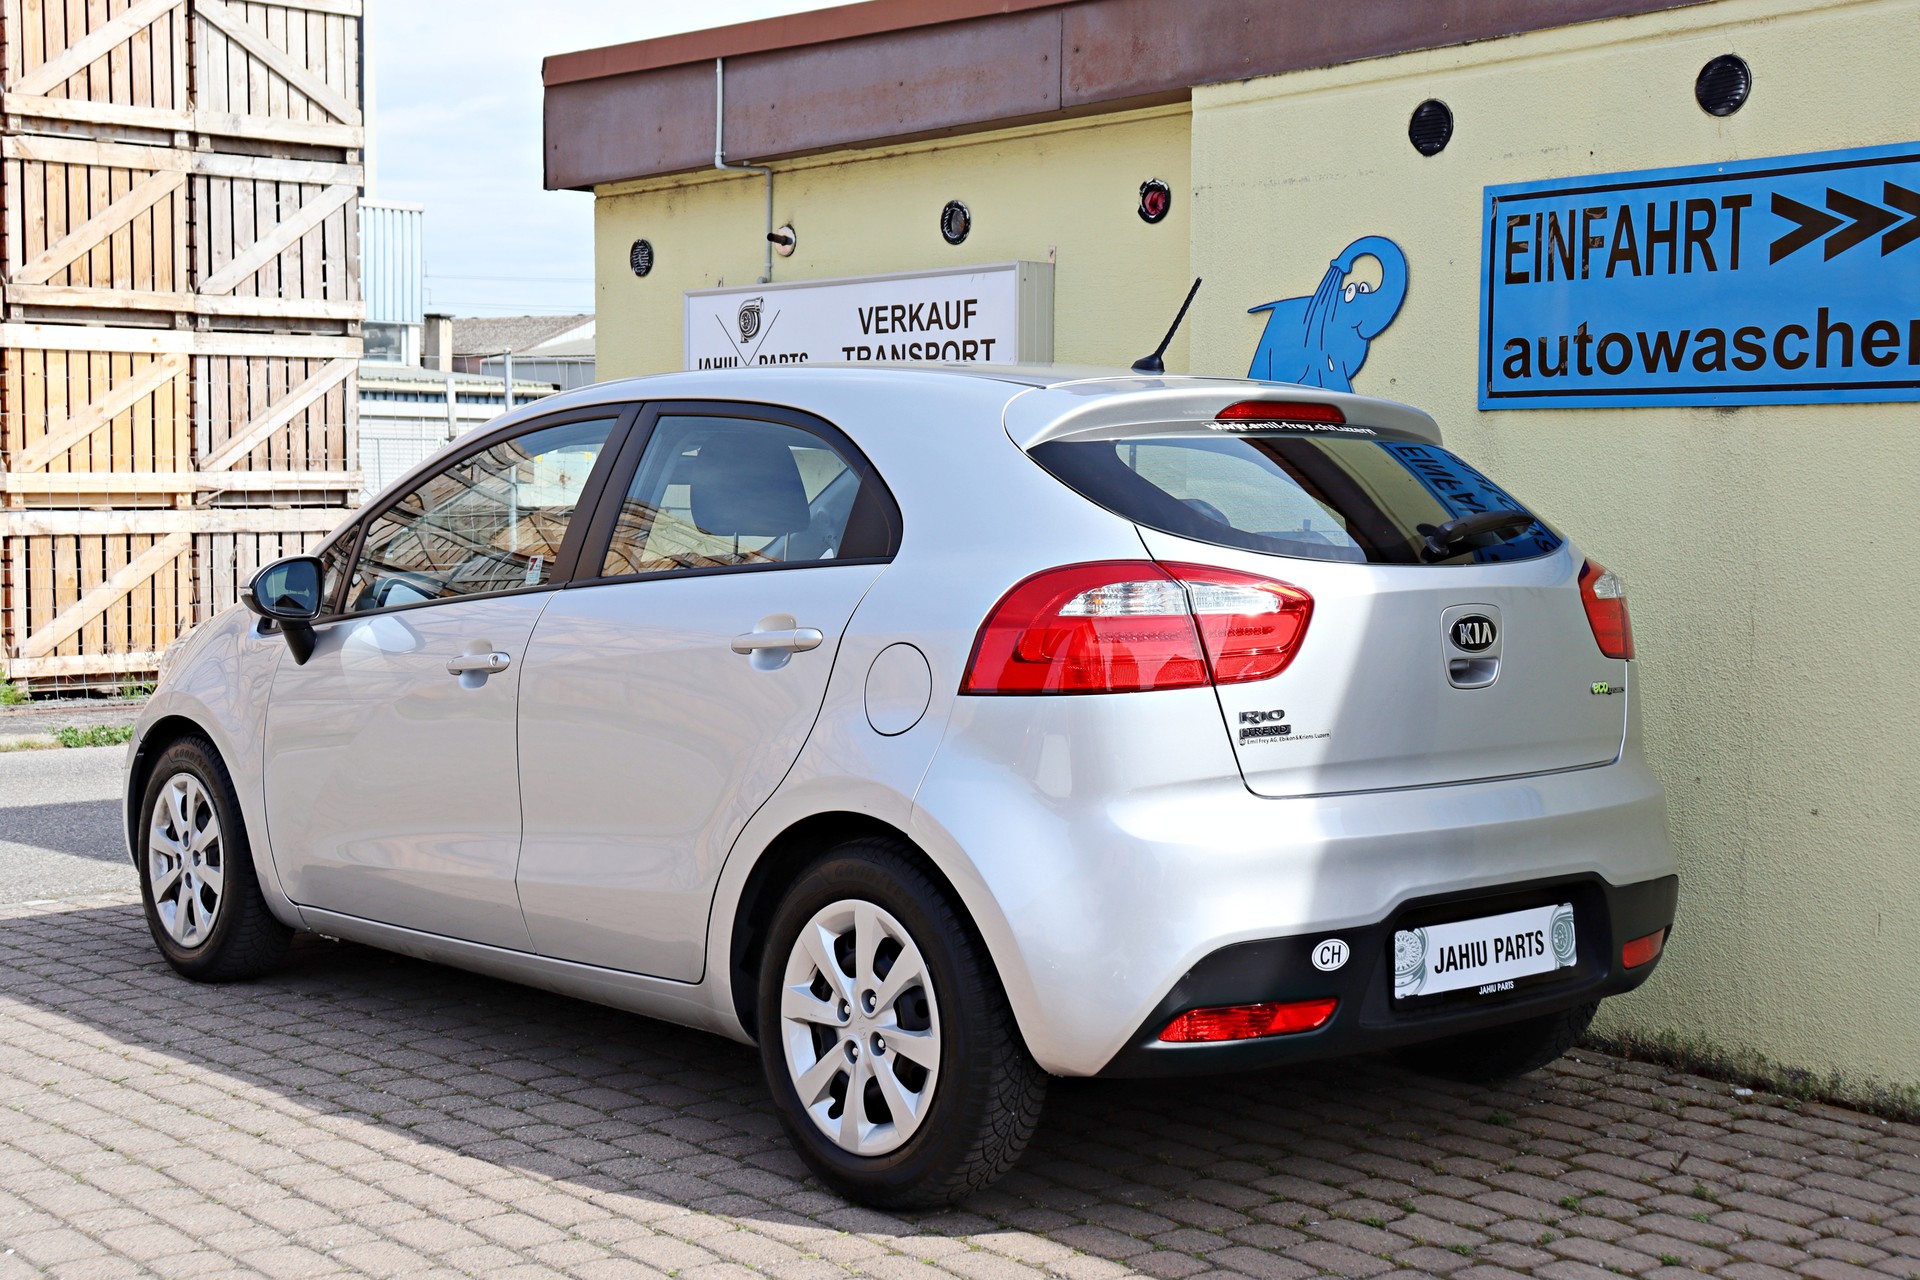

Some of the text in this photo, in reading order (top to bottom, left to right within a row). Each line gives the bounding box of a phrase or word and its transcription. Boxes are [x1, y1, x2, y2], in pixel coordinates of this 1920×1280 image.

[1505, 193, 1752, 284] EINFAHRT
[858, 299, 977, 335] VERKAUF
[1458, 622, 1493, 645] KIA
[1239, 709, 1285, 725] RIO
[1246, 725, 1289, 737] TREND
[1320, 944, 1342, 965] CH
[1434, 930, 1545, 974] JAHIU PARTS
[1479, 980, 1514, 995] JAHIU PARTS
